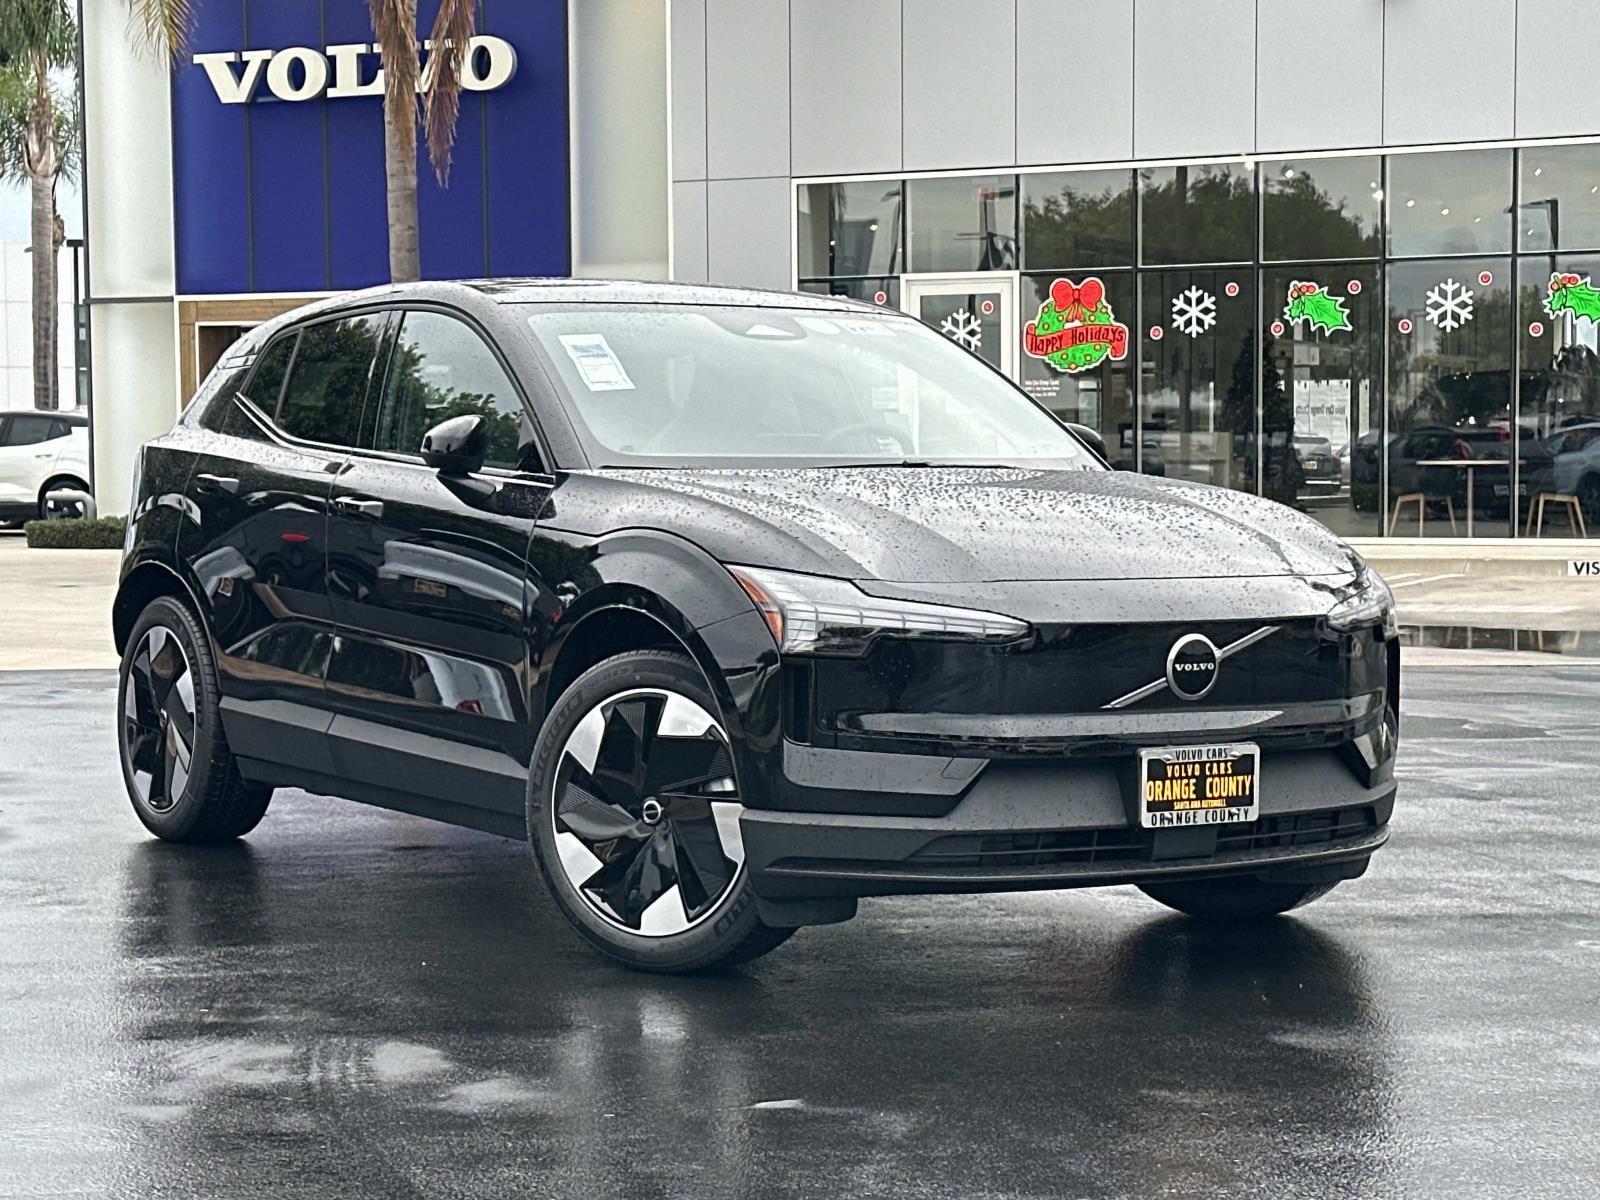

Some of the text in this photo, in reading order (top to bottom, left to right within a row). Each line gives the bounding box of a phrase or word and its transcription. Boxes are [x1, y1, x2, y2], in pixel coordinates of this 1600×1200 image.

[1071, 327, 1124, 345] Holidays
[1174, 662, 1214, 671] VOLVO
[1175, 748, 1228, 761] VOLVO CARS
[1166, 762, 1232, 777] VOLVO CARS
[1146, 775, 1251, 801] ORANGE COUNTY
[1151, 808, 1249, 826] ORANGE COUNTY
